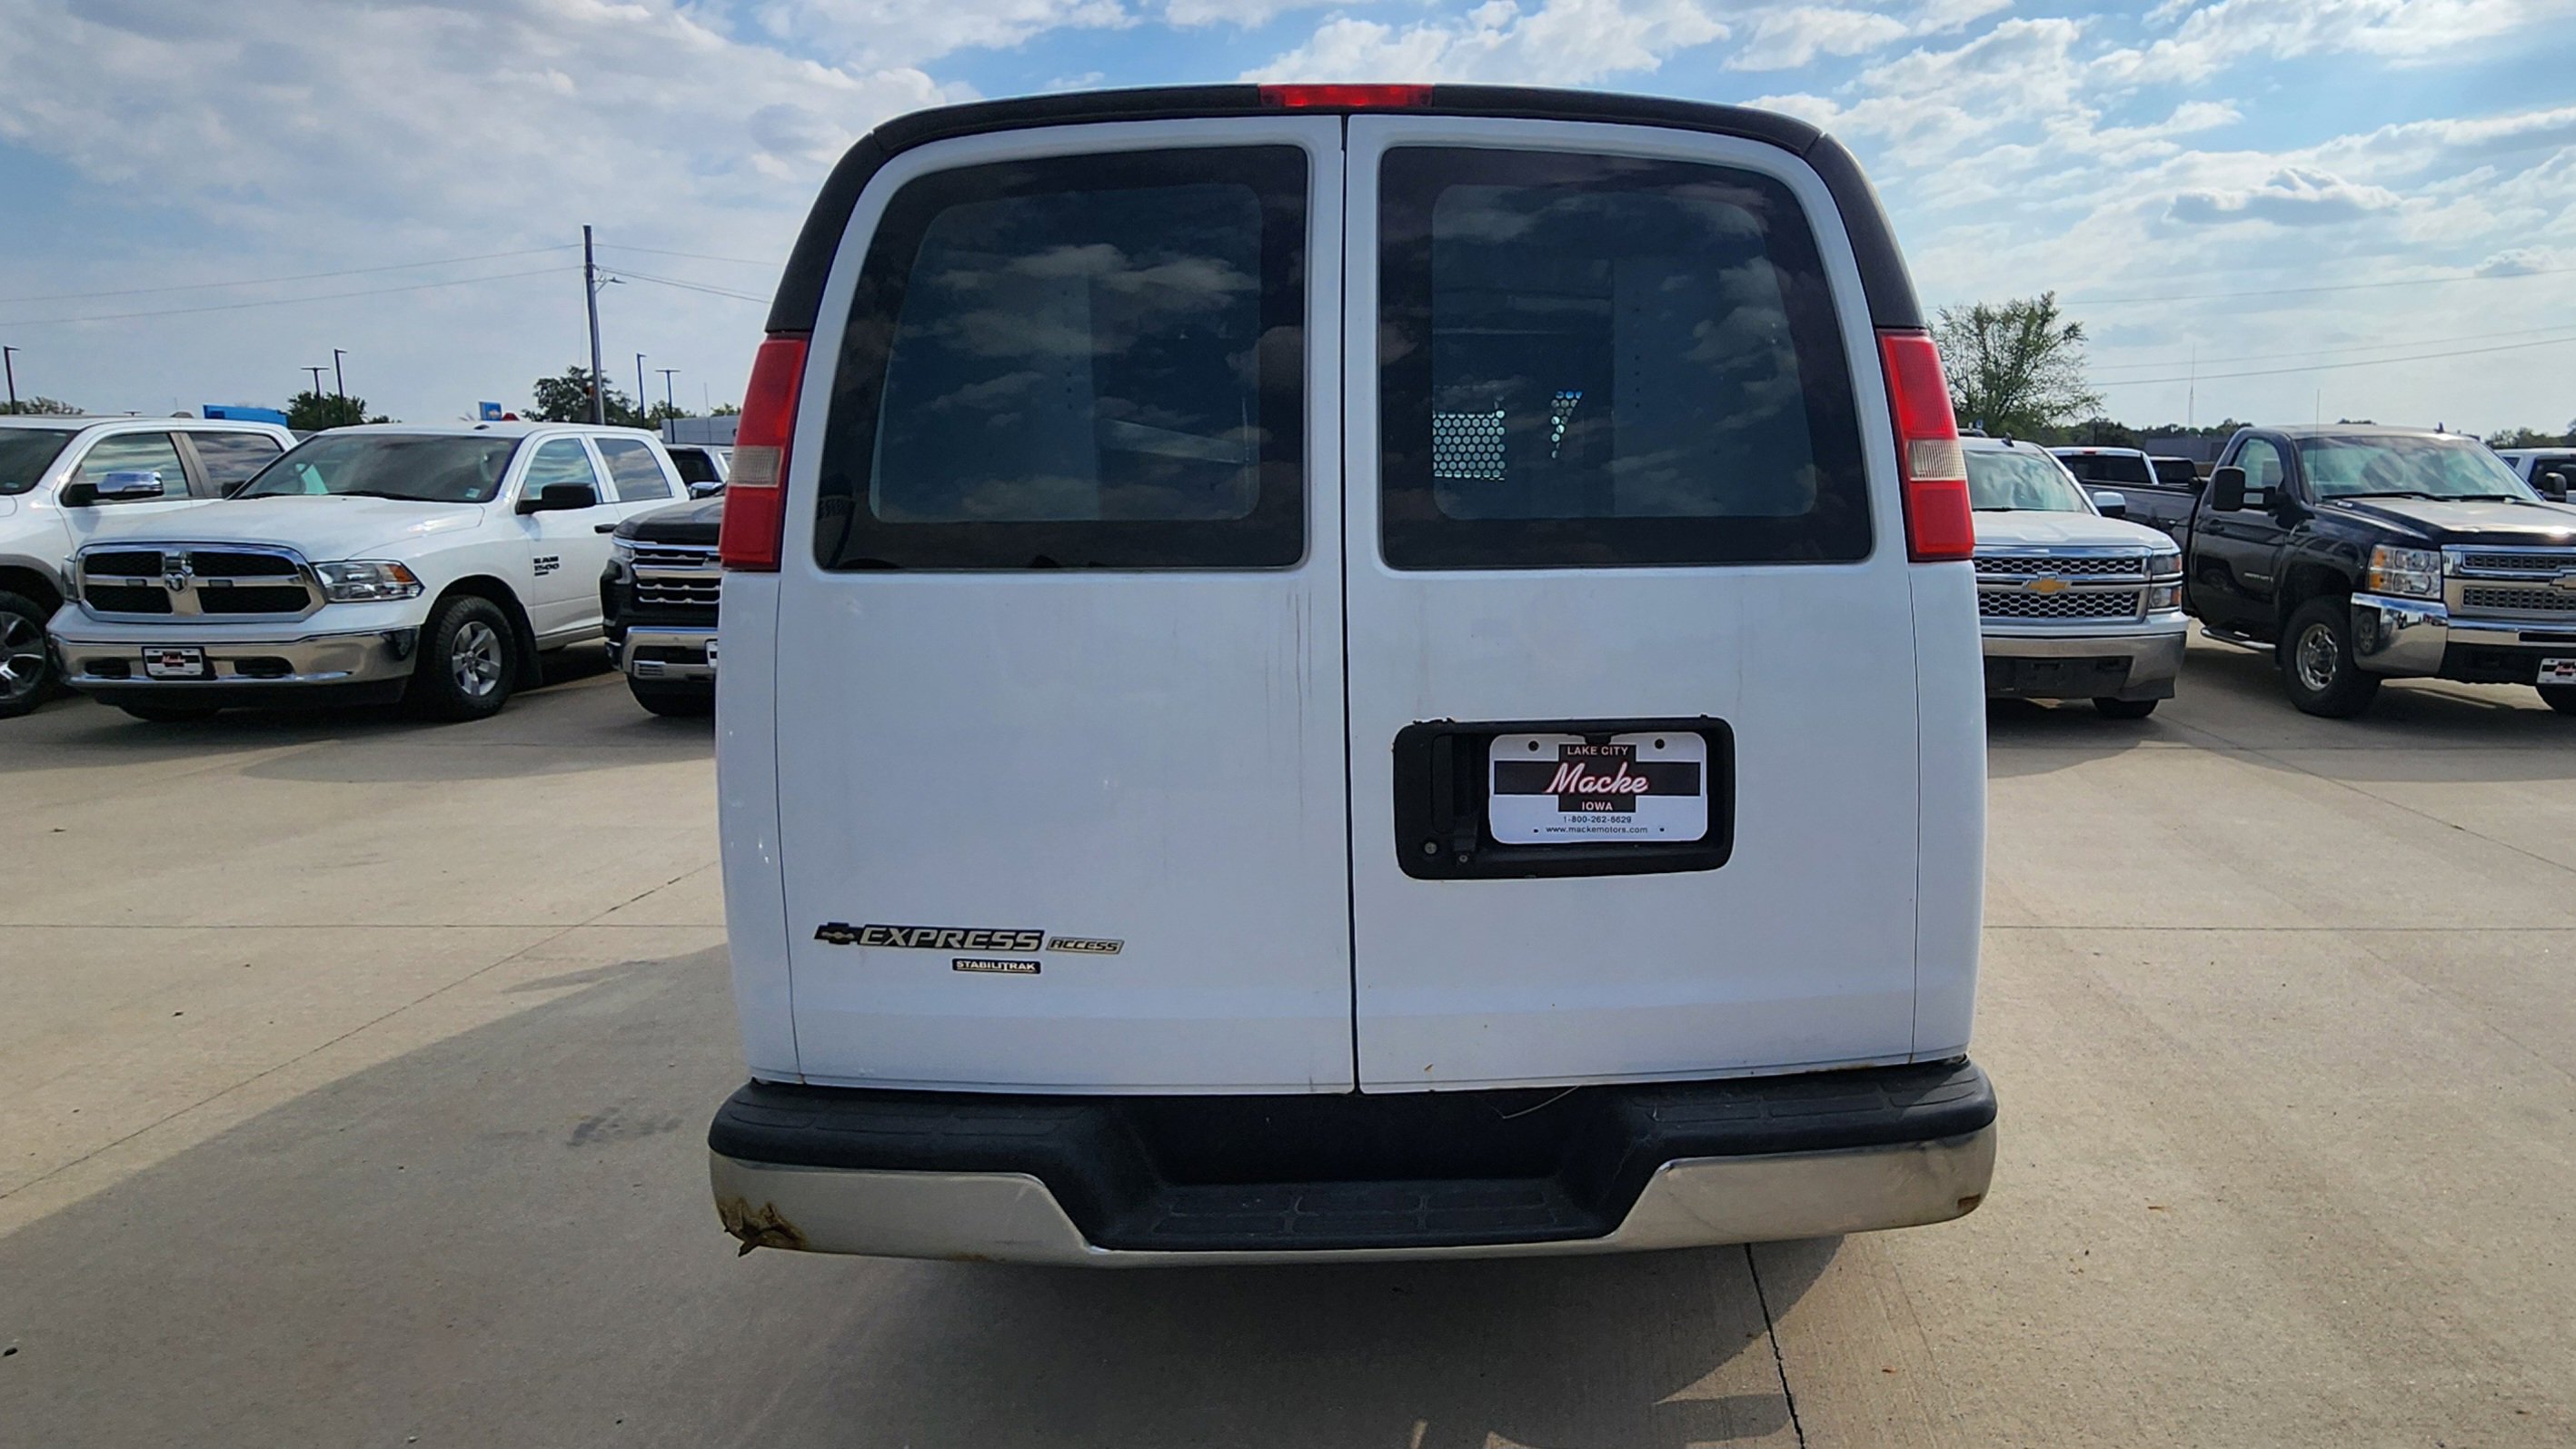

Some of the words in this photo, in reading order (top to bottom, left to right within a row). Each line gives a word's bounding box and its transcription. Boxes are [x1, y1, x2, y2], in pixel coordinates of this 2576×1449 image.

[1567, 746, 1597, 756] LAKE
[1601, 746, 1628, 756] CITY
[1544, 761, 1649, 793] Macke
[1582, 801, 1613, 811] IOWA
[1546, 826, 1648, 834] www.mackemotors.com
[860, 927, 1041, 952] EXPRESS
[1050, 939, 1119, 951] ACCESS
[956, 960, 1036, 971] STABILITRAK
